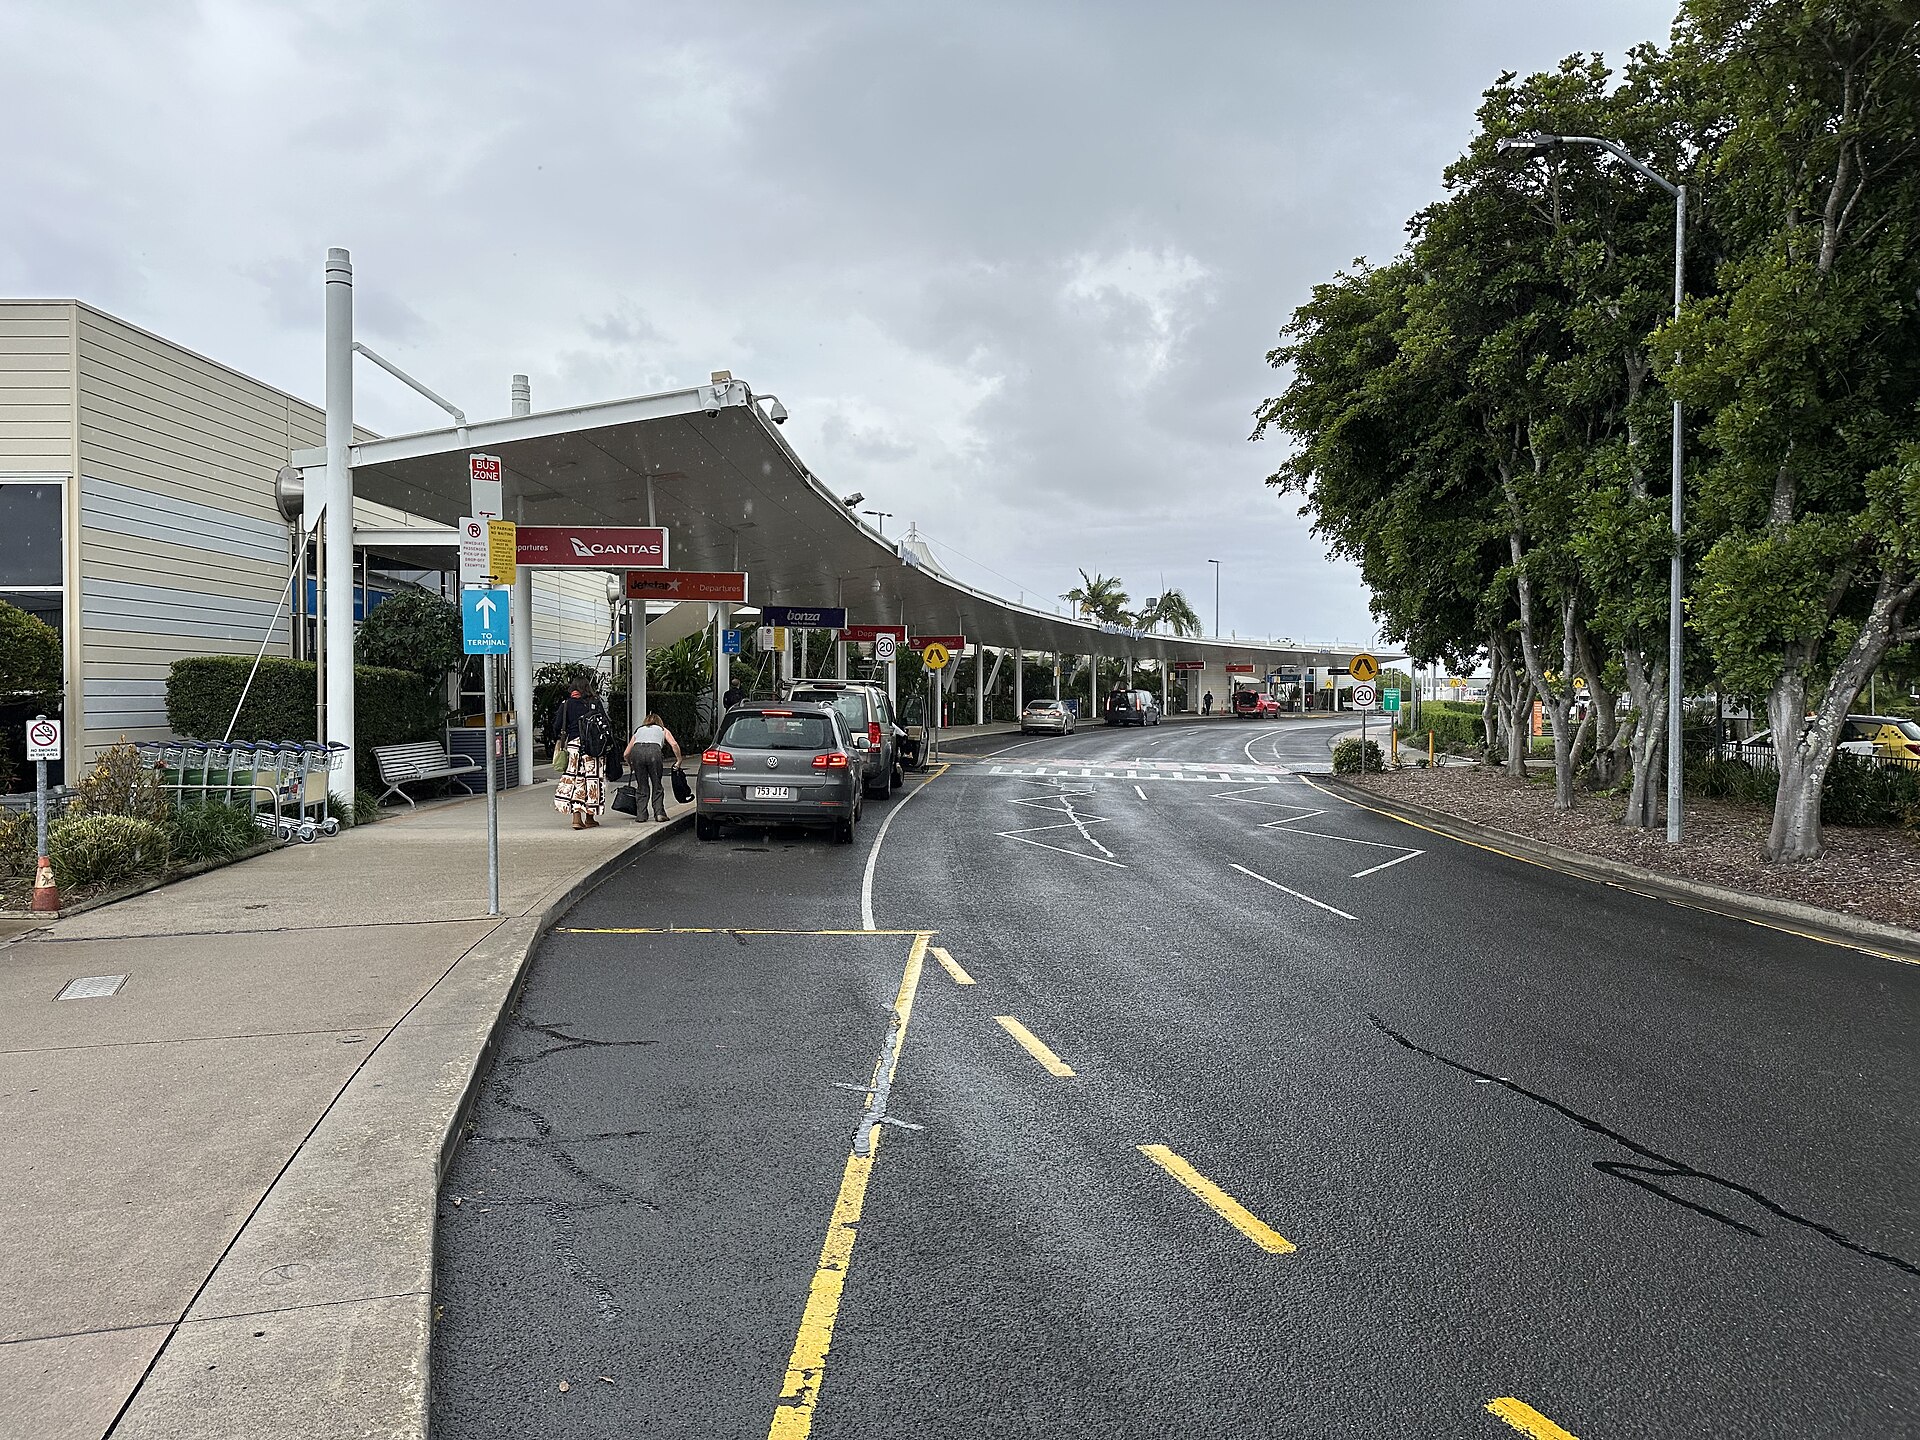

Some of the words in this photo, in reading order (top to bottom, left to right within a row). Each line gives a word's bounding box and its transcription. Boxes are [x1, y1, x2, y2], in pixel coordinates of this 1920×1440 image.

[476, 461, 495, 470] BUS
[473, 470, 498, 480] ZONE
[516, 544, 549, 552] partures
[590, 543, 661, 554] QANTAS
[630, 580, 670, 591] Jetstar
[700, 584, 742, 592] Departures
[786, 609, 821, 622] bonza
[728, 632, 736, 640] P
[879, 642, 892, 652] 20
[1356, 690, 1372, 701] 20
[757, 786, 770, 796] 753
